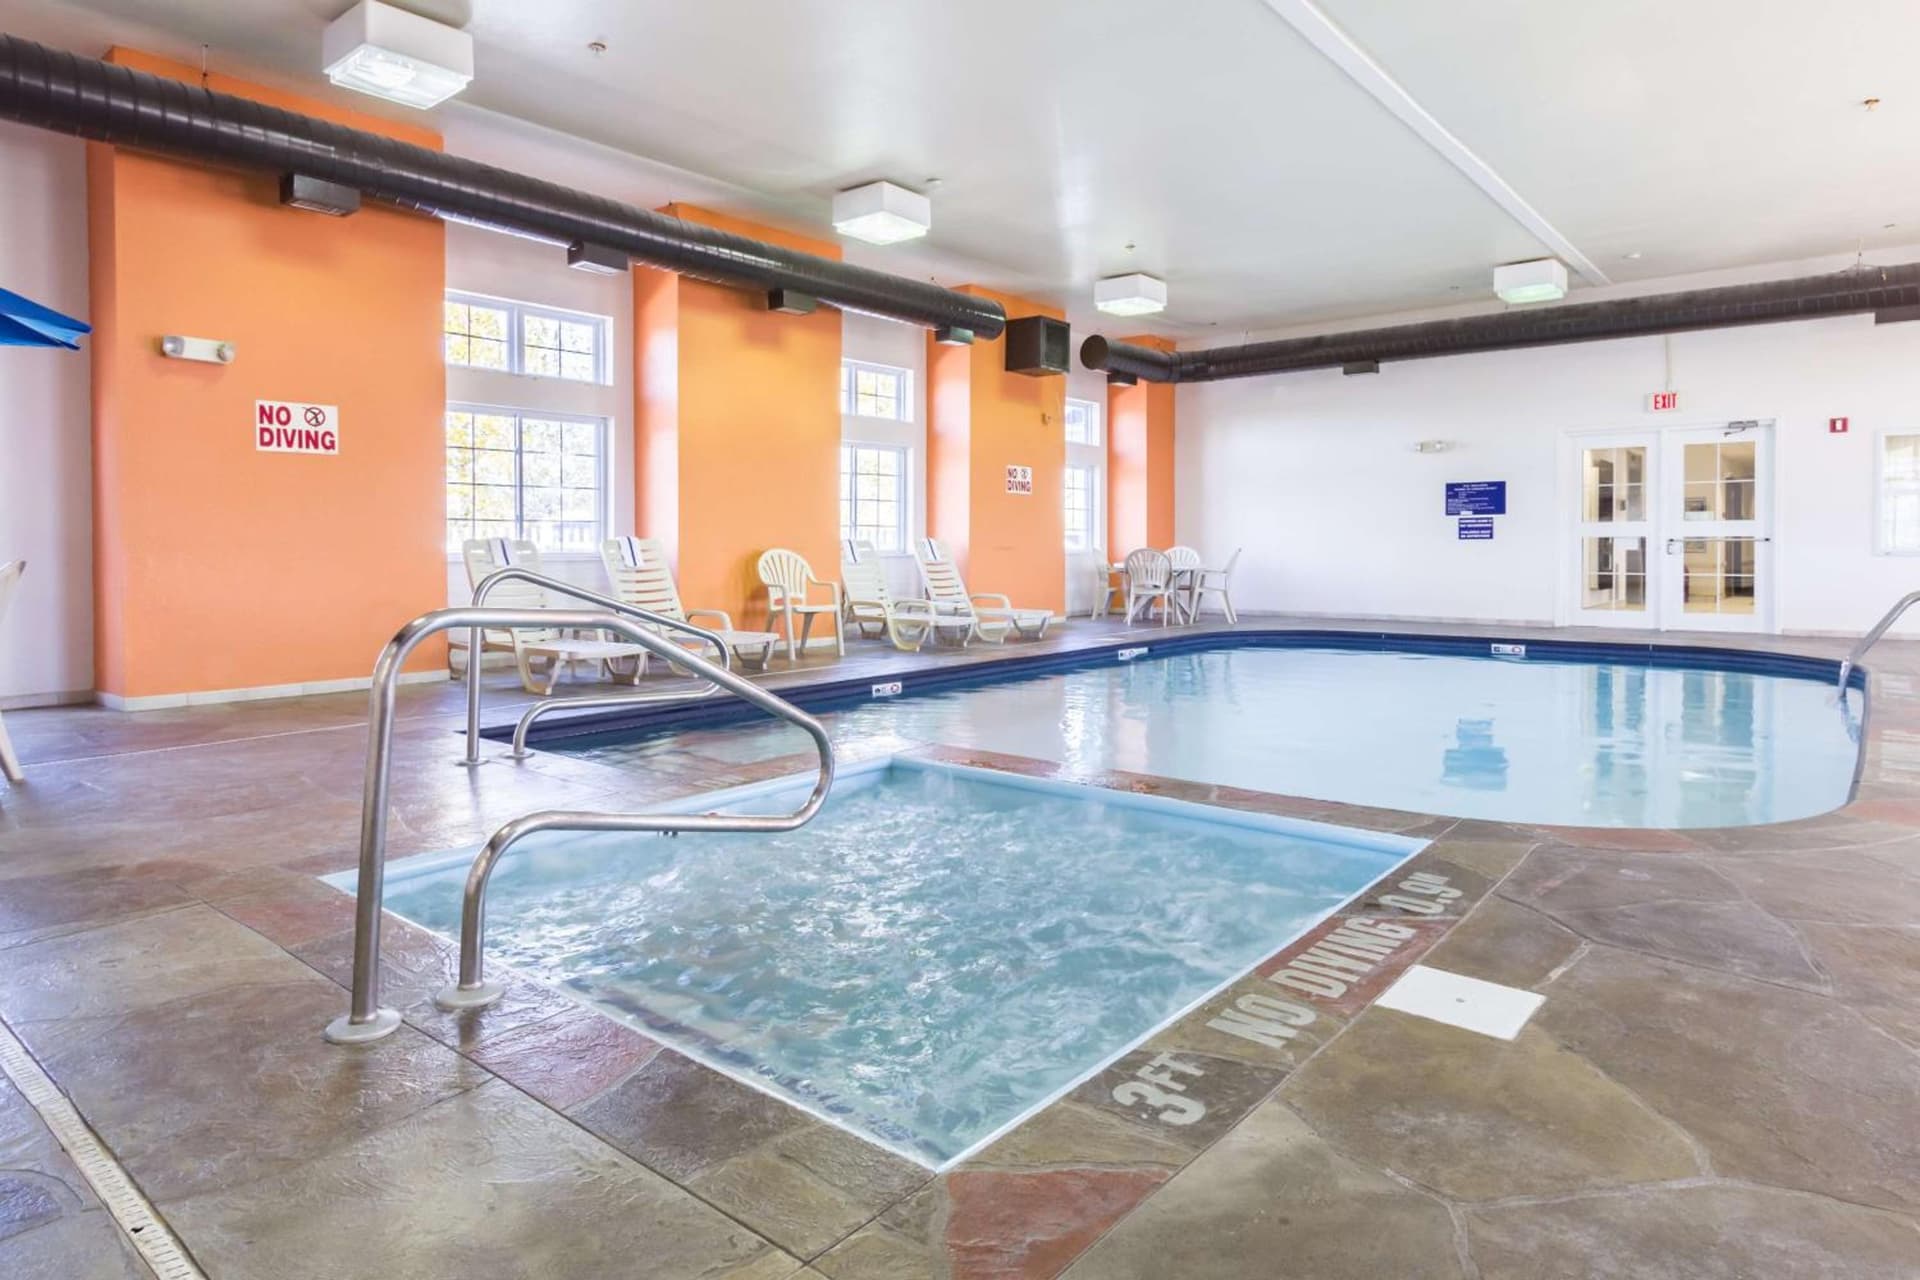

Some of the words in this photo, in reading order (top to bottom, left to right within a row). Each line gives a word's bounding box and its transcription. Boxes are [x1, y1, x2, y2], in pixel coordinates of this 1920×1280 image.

[1654, 393, 1677, 409] EXIT
[259, 404, 291, 426] NO
[259, 427, 336, 450] DIVING
[1007, 468, 1018, 479] NO
[1007, 480, 1031, 492] DIVING
[1206, 993, 1317, 1049] NO
[1268, 916, 1417, 998] DIVING
